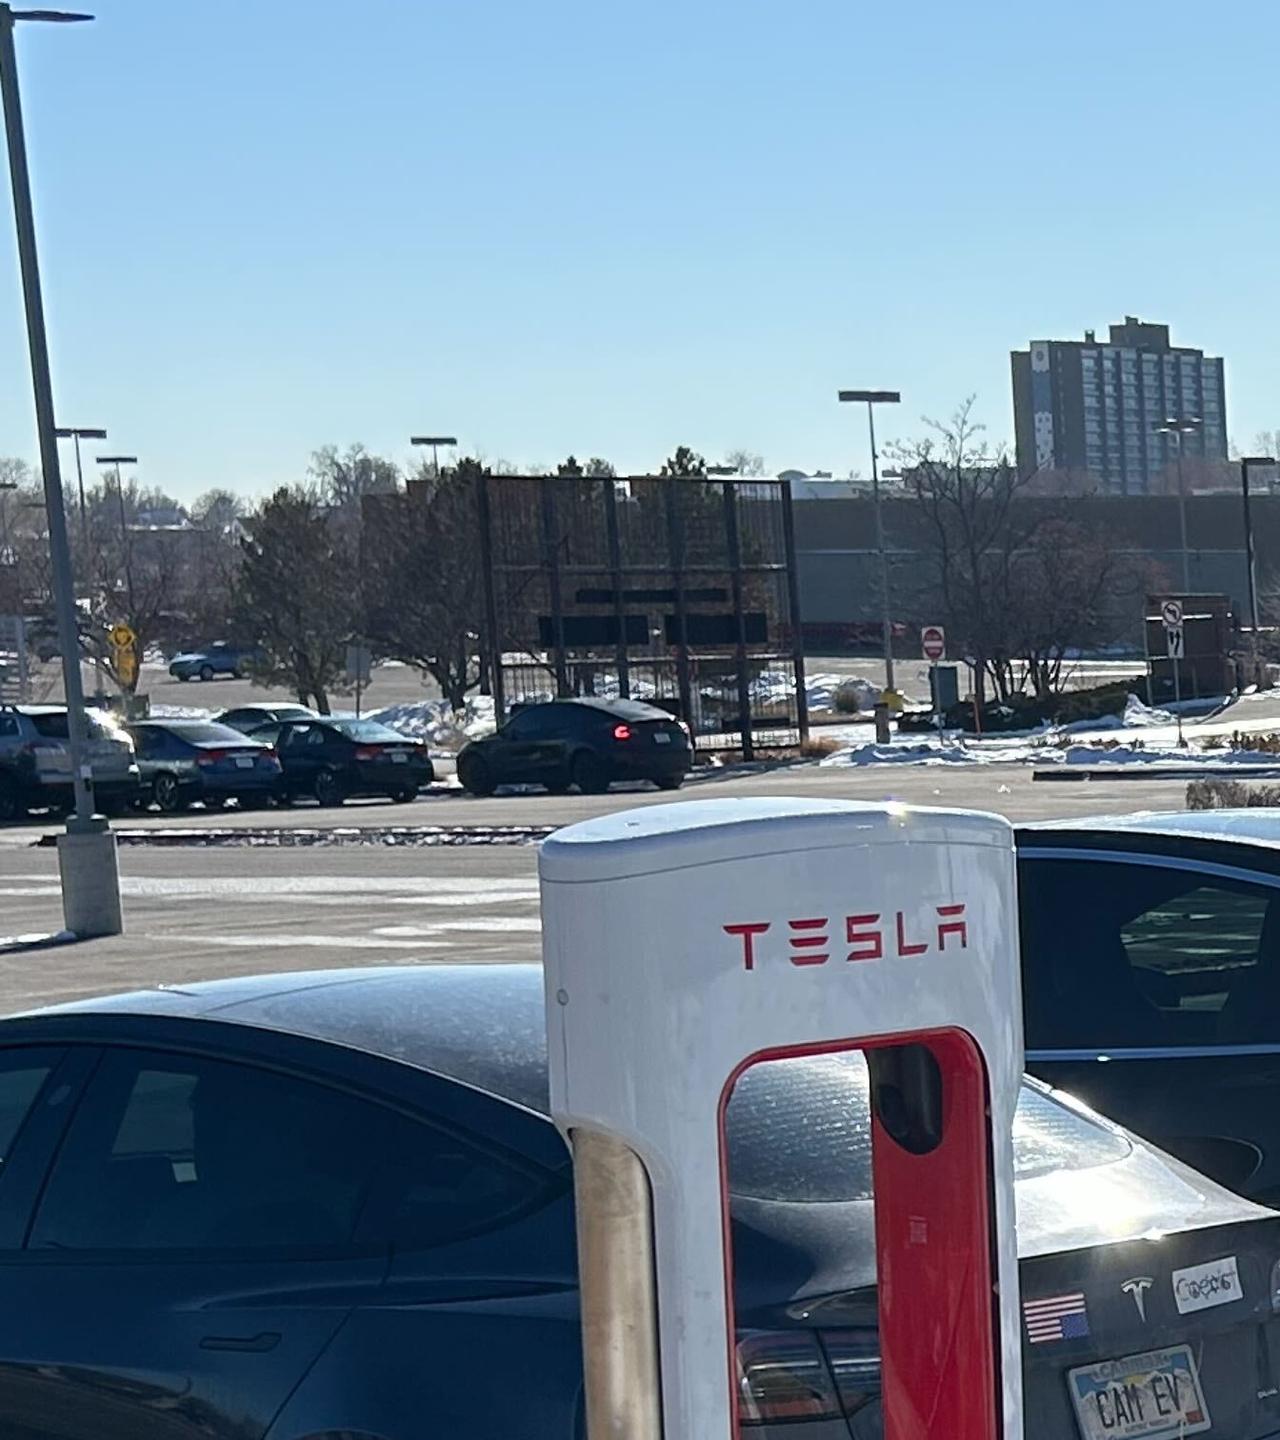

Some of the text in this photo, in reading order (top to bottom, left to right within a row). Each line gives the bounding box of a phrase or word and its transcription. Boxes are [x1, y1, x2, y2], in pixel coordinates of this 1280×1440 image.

[722, 903, 968, 971] TESLA
[1095, 1374, 1182, 1429] CAM EV
